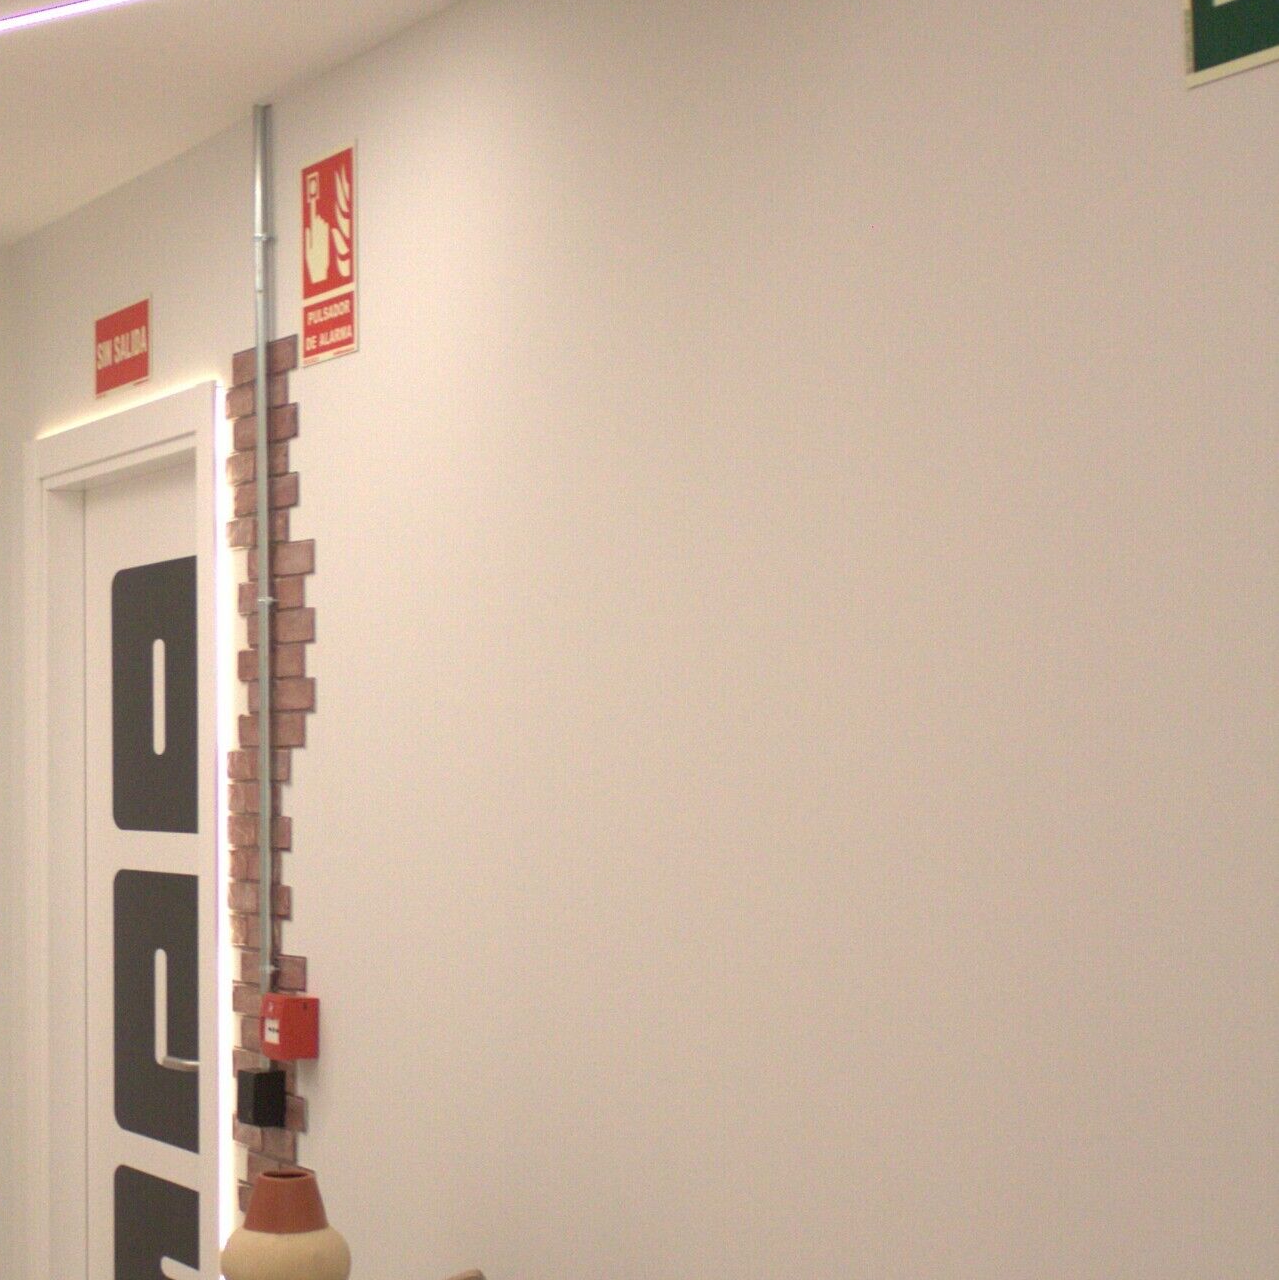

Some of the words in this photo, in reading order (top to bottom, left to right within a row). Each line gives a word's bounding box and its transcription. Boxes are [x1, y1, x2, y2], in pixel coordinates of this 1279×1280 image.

[307, 299, 351, 325] PULSADOR
[97, 339, 113, 370] SIN
[113, 325, 147, 364] SALIDA
[306, 335, 318, 351] DE
[319, 324, 353, 347] ALARMA
